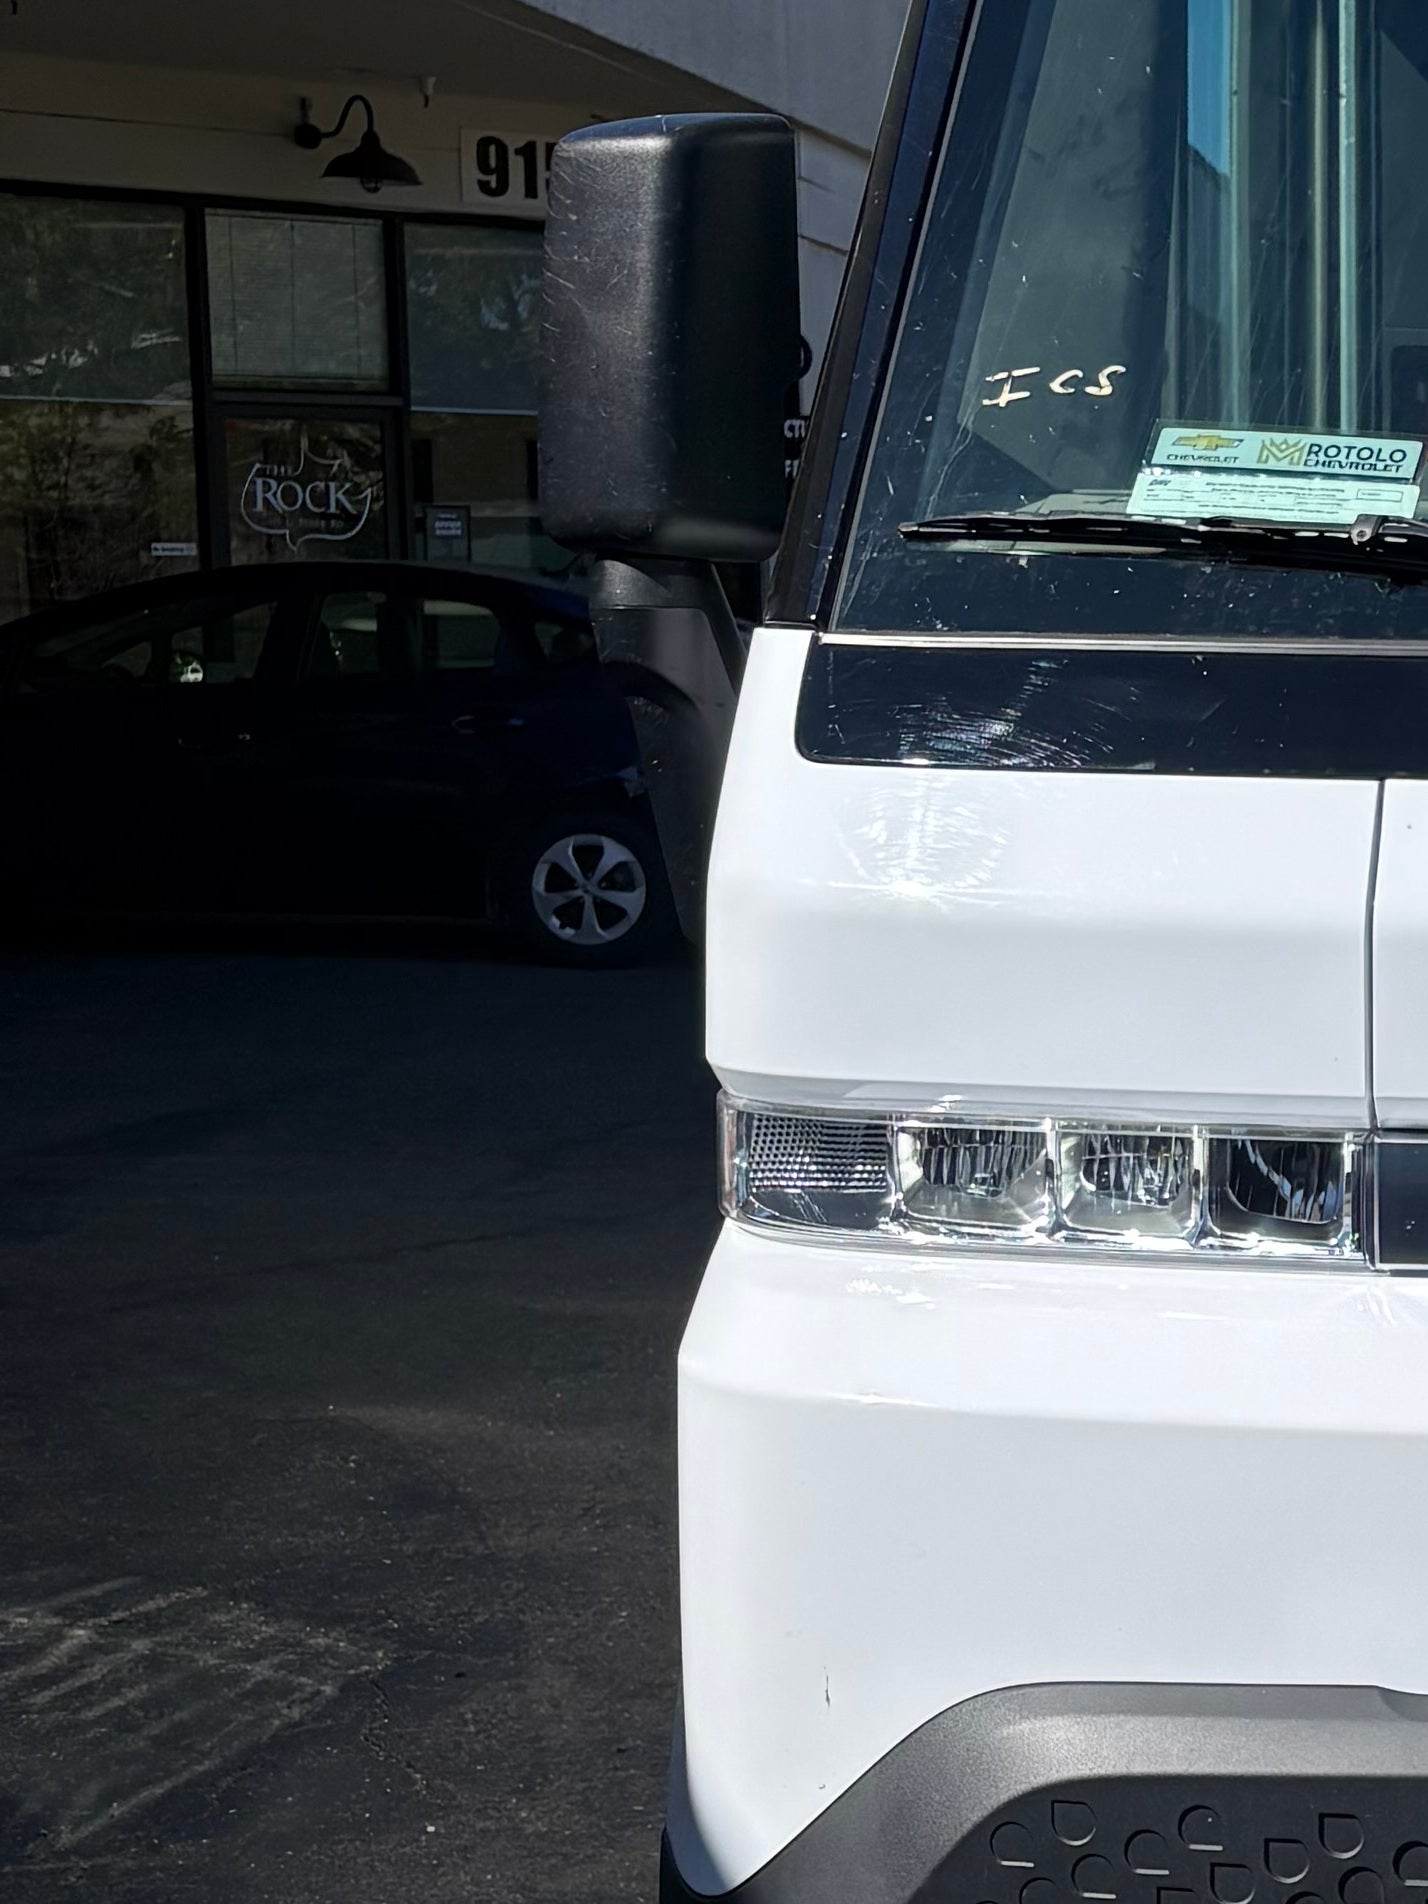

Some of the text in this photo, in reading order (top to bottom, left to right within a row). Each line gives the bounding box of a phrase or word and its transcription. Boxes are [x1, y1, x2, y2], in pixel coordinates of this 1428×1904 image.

[476, 135, 557, 199] 91
[1166, 453, 1240, 464] CHEVROLET
[1306, 443, 1407, 463] ROTOLO
[1303, 458, 1404, 473] CHEVROLET
[252, 477, 359, 515] ROCK
